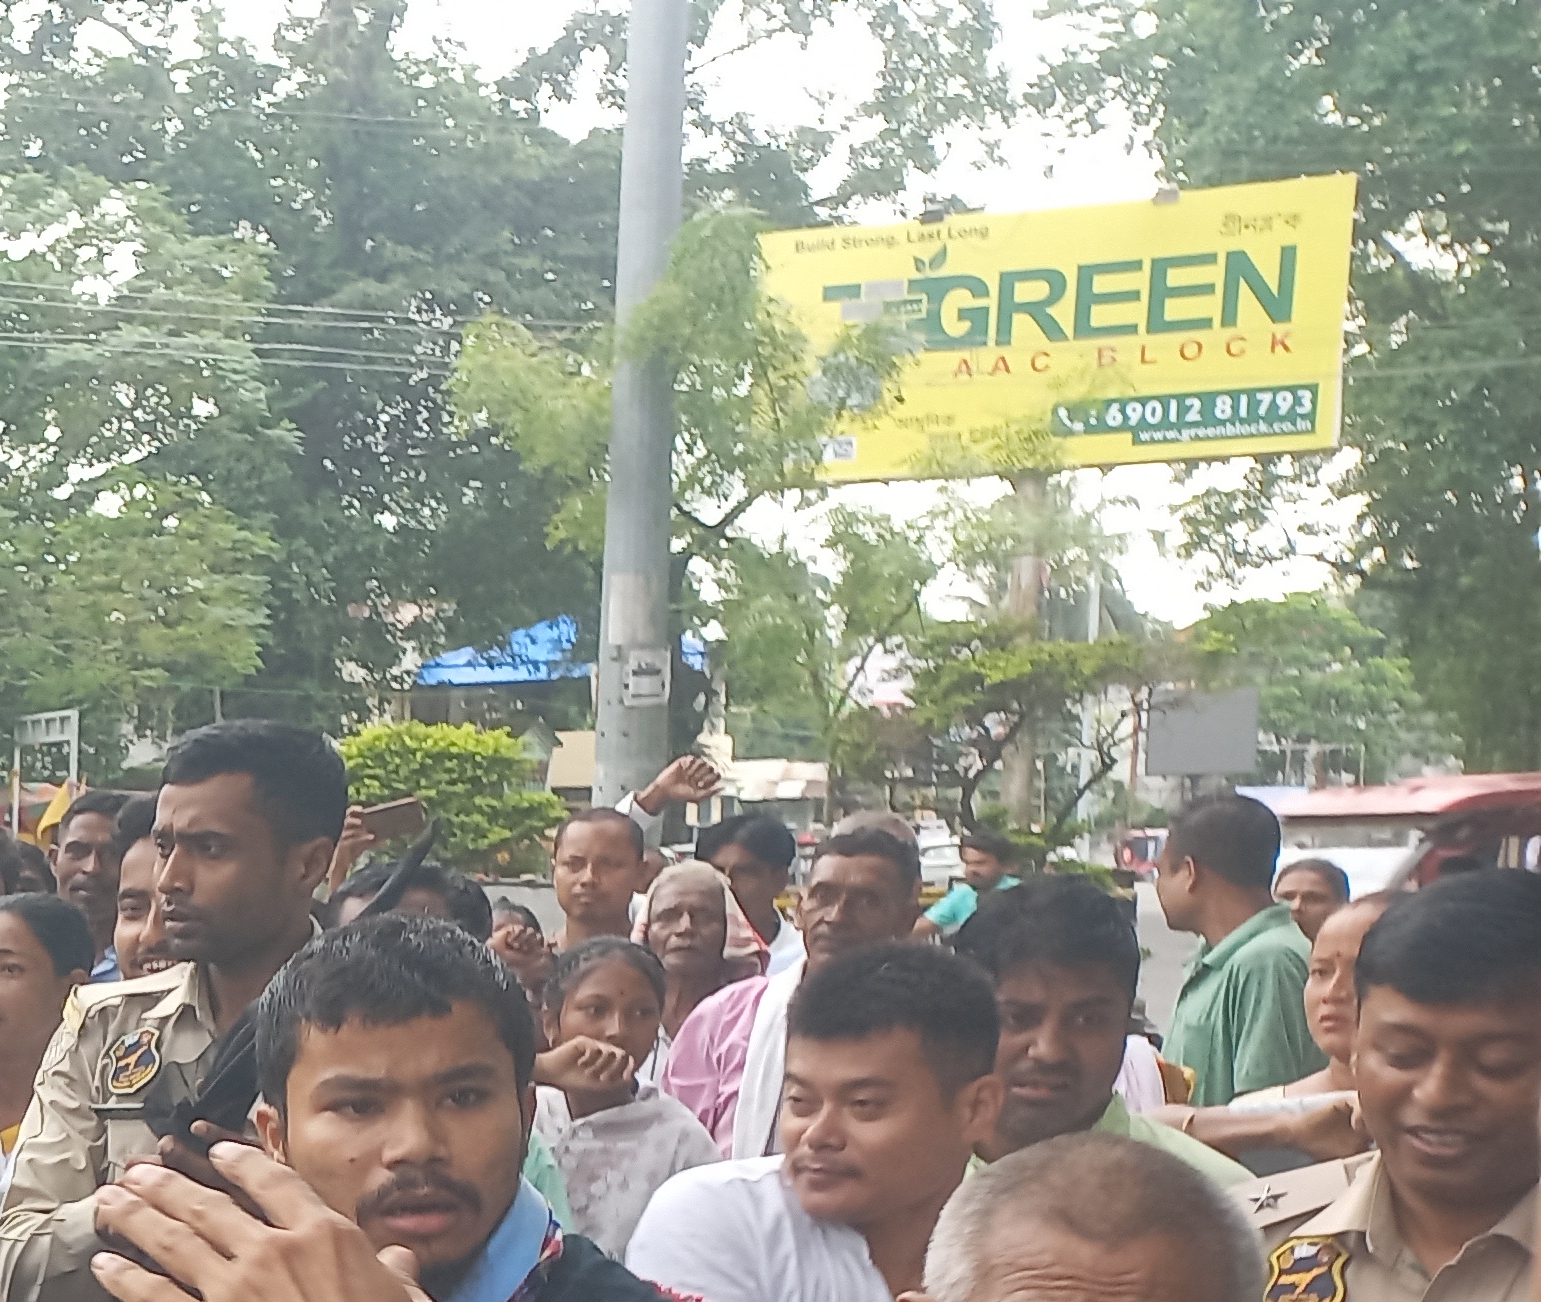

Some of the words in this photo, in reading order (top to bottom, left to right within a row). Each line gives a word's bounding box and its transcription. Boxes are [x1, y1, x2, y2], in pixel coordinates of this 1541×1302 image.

[795, 237, 835, 252] Build
[907, 227, 941, 243] Last
[947, 222, 989, 240] Long
[908, 245, 1297, 351] GREEN
[954, 352, 1052, 379] AAC
[1097, 331, 1293, 369] BLOCK
[1105, 398, 1202, 427] 69012
[1214, 389, 1313, 420] 81793
[1139, 416, 1312, 442] www.greenblock.co.in
